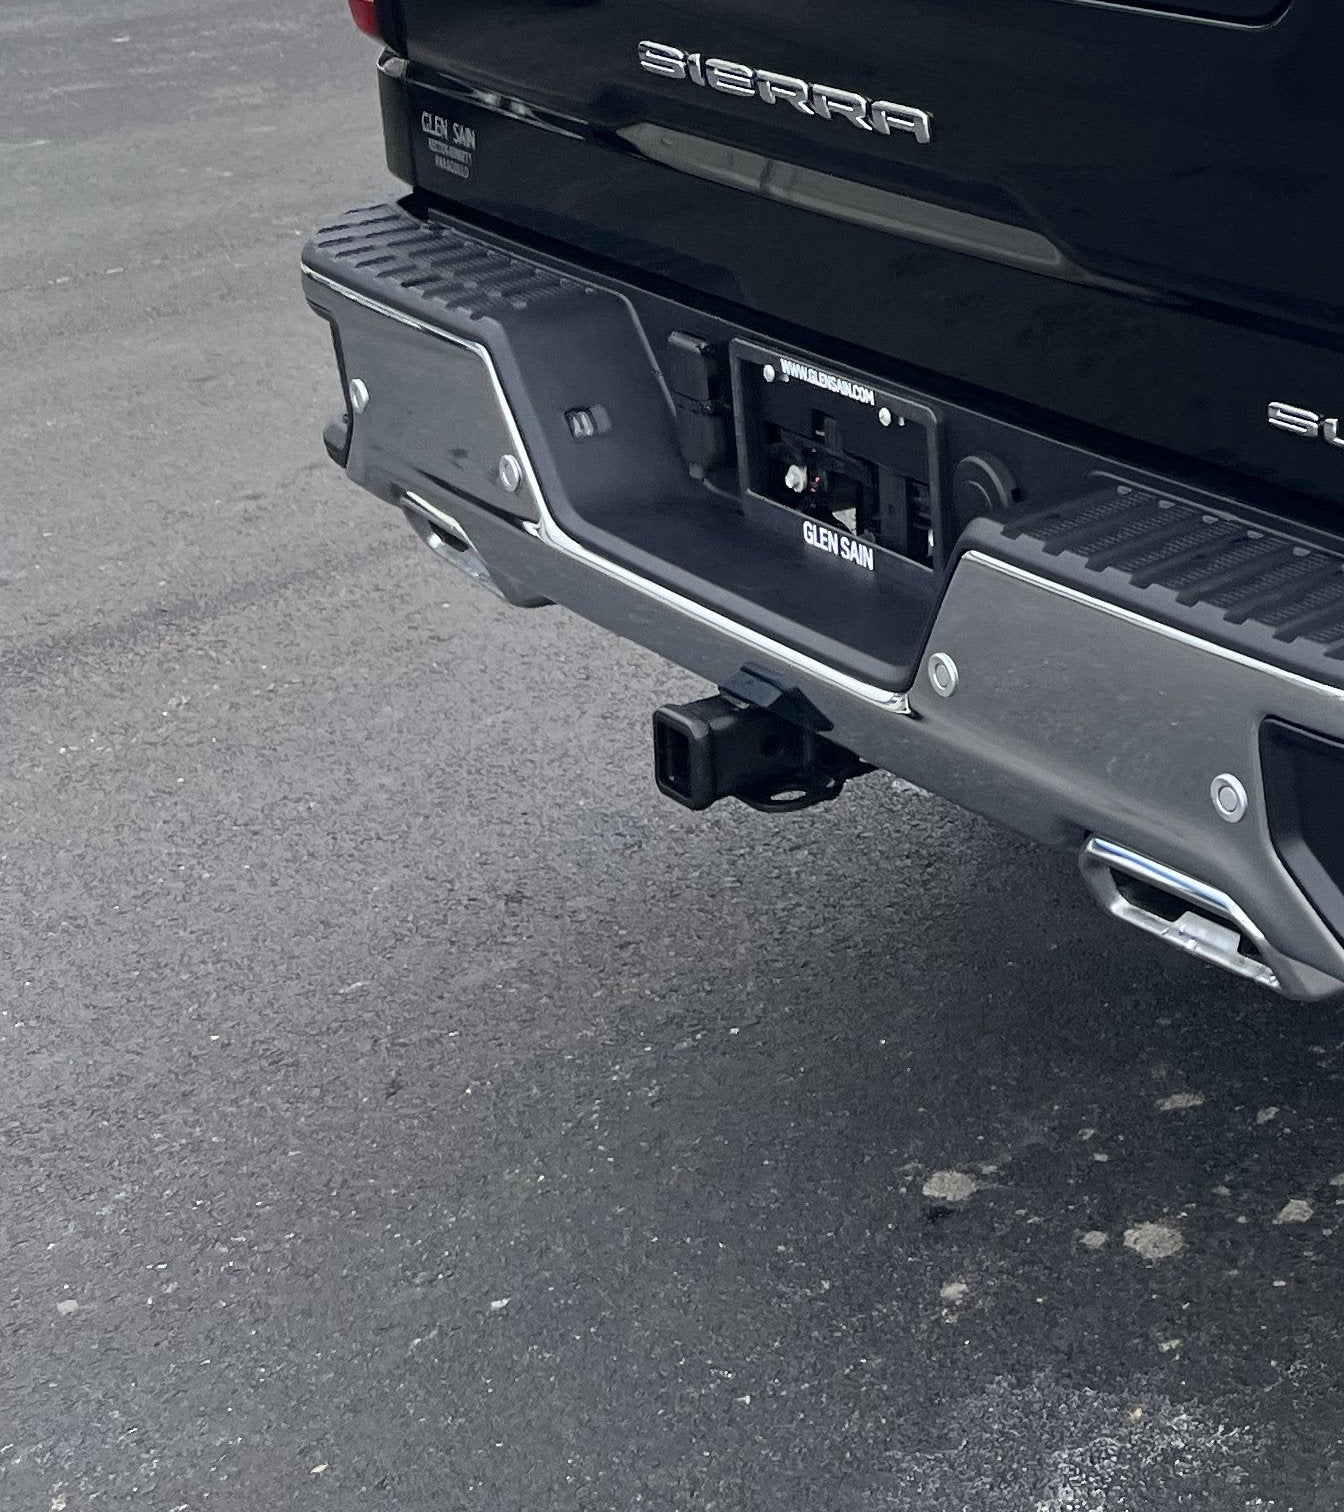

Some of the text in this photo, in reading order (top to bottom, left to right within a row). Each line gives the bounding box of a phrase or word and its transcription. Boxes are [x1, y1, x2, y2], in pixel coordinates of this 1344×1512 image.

[638, 40, 934, 144] SIERRA
[803, 520, 874, 571] GLEN SAIN
